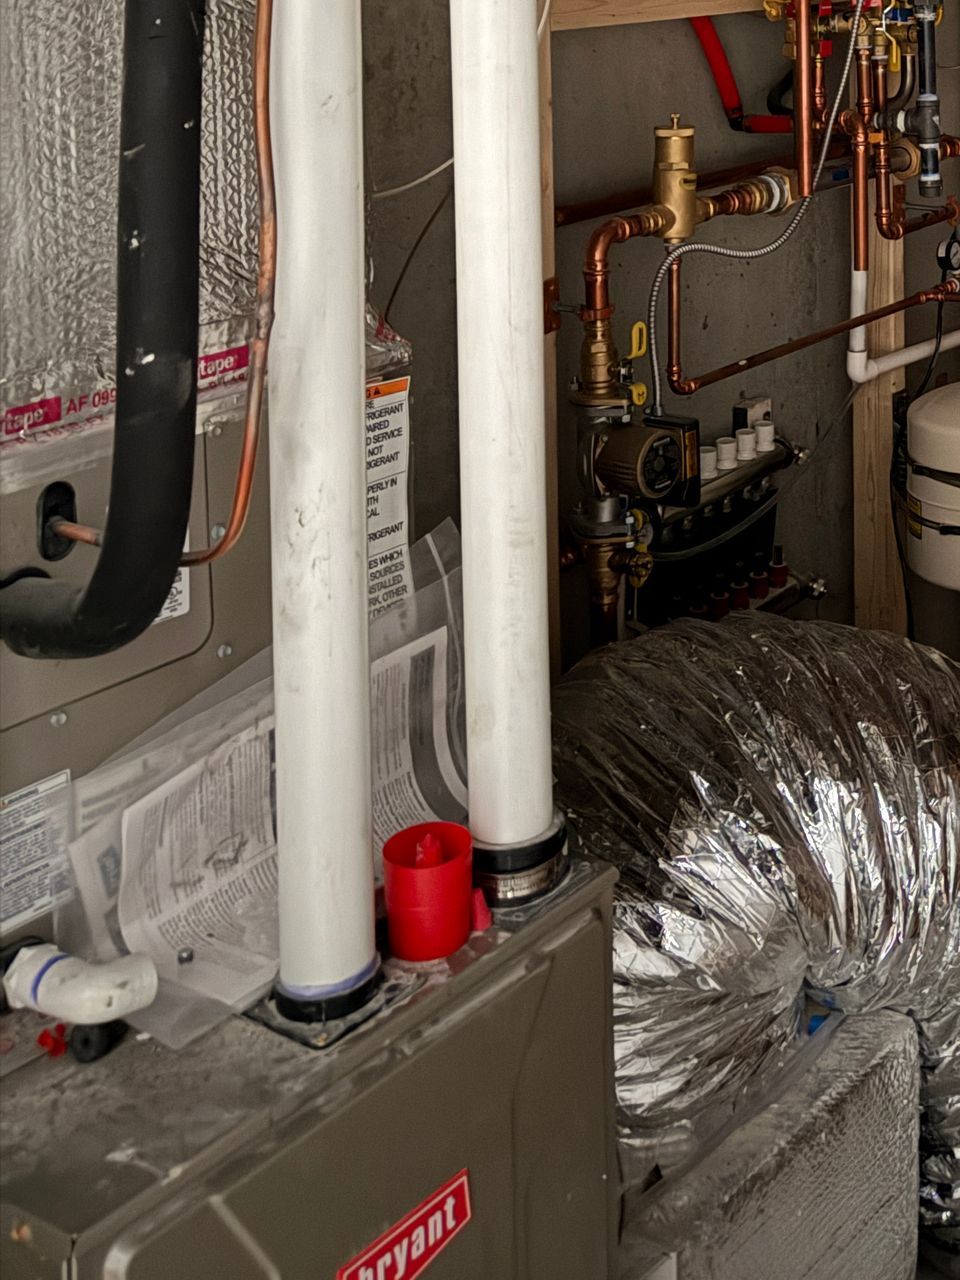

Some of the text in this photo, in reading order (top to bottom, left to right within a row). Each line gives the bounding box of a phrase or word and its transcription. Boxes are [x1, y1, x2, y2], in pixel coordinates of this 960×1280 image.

[66, 394, 88, 415] AF
[92, 388, 117, 408] 099
[366, 403, 404, 420] RIGERANT
[366, 419, 390, 433] AIRED
[373, 426, 403, 444] SERVICE
[368, 444, 384, 458] NOT
[379, 548, 403, 565] WHICH
[370, 561, 405, 582] SOURCES
[382, 585, 408, 602] OTHER
[358, 1195, 456, 1280] ryant
